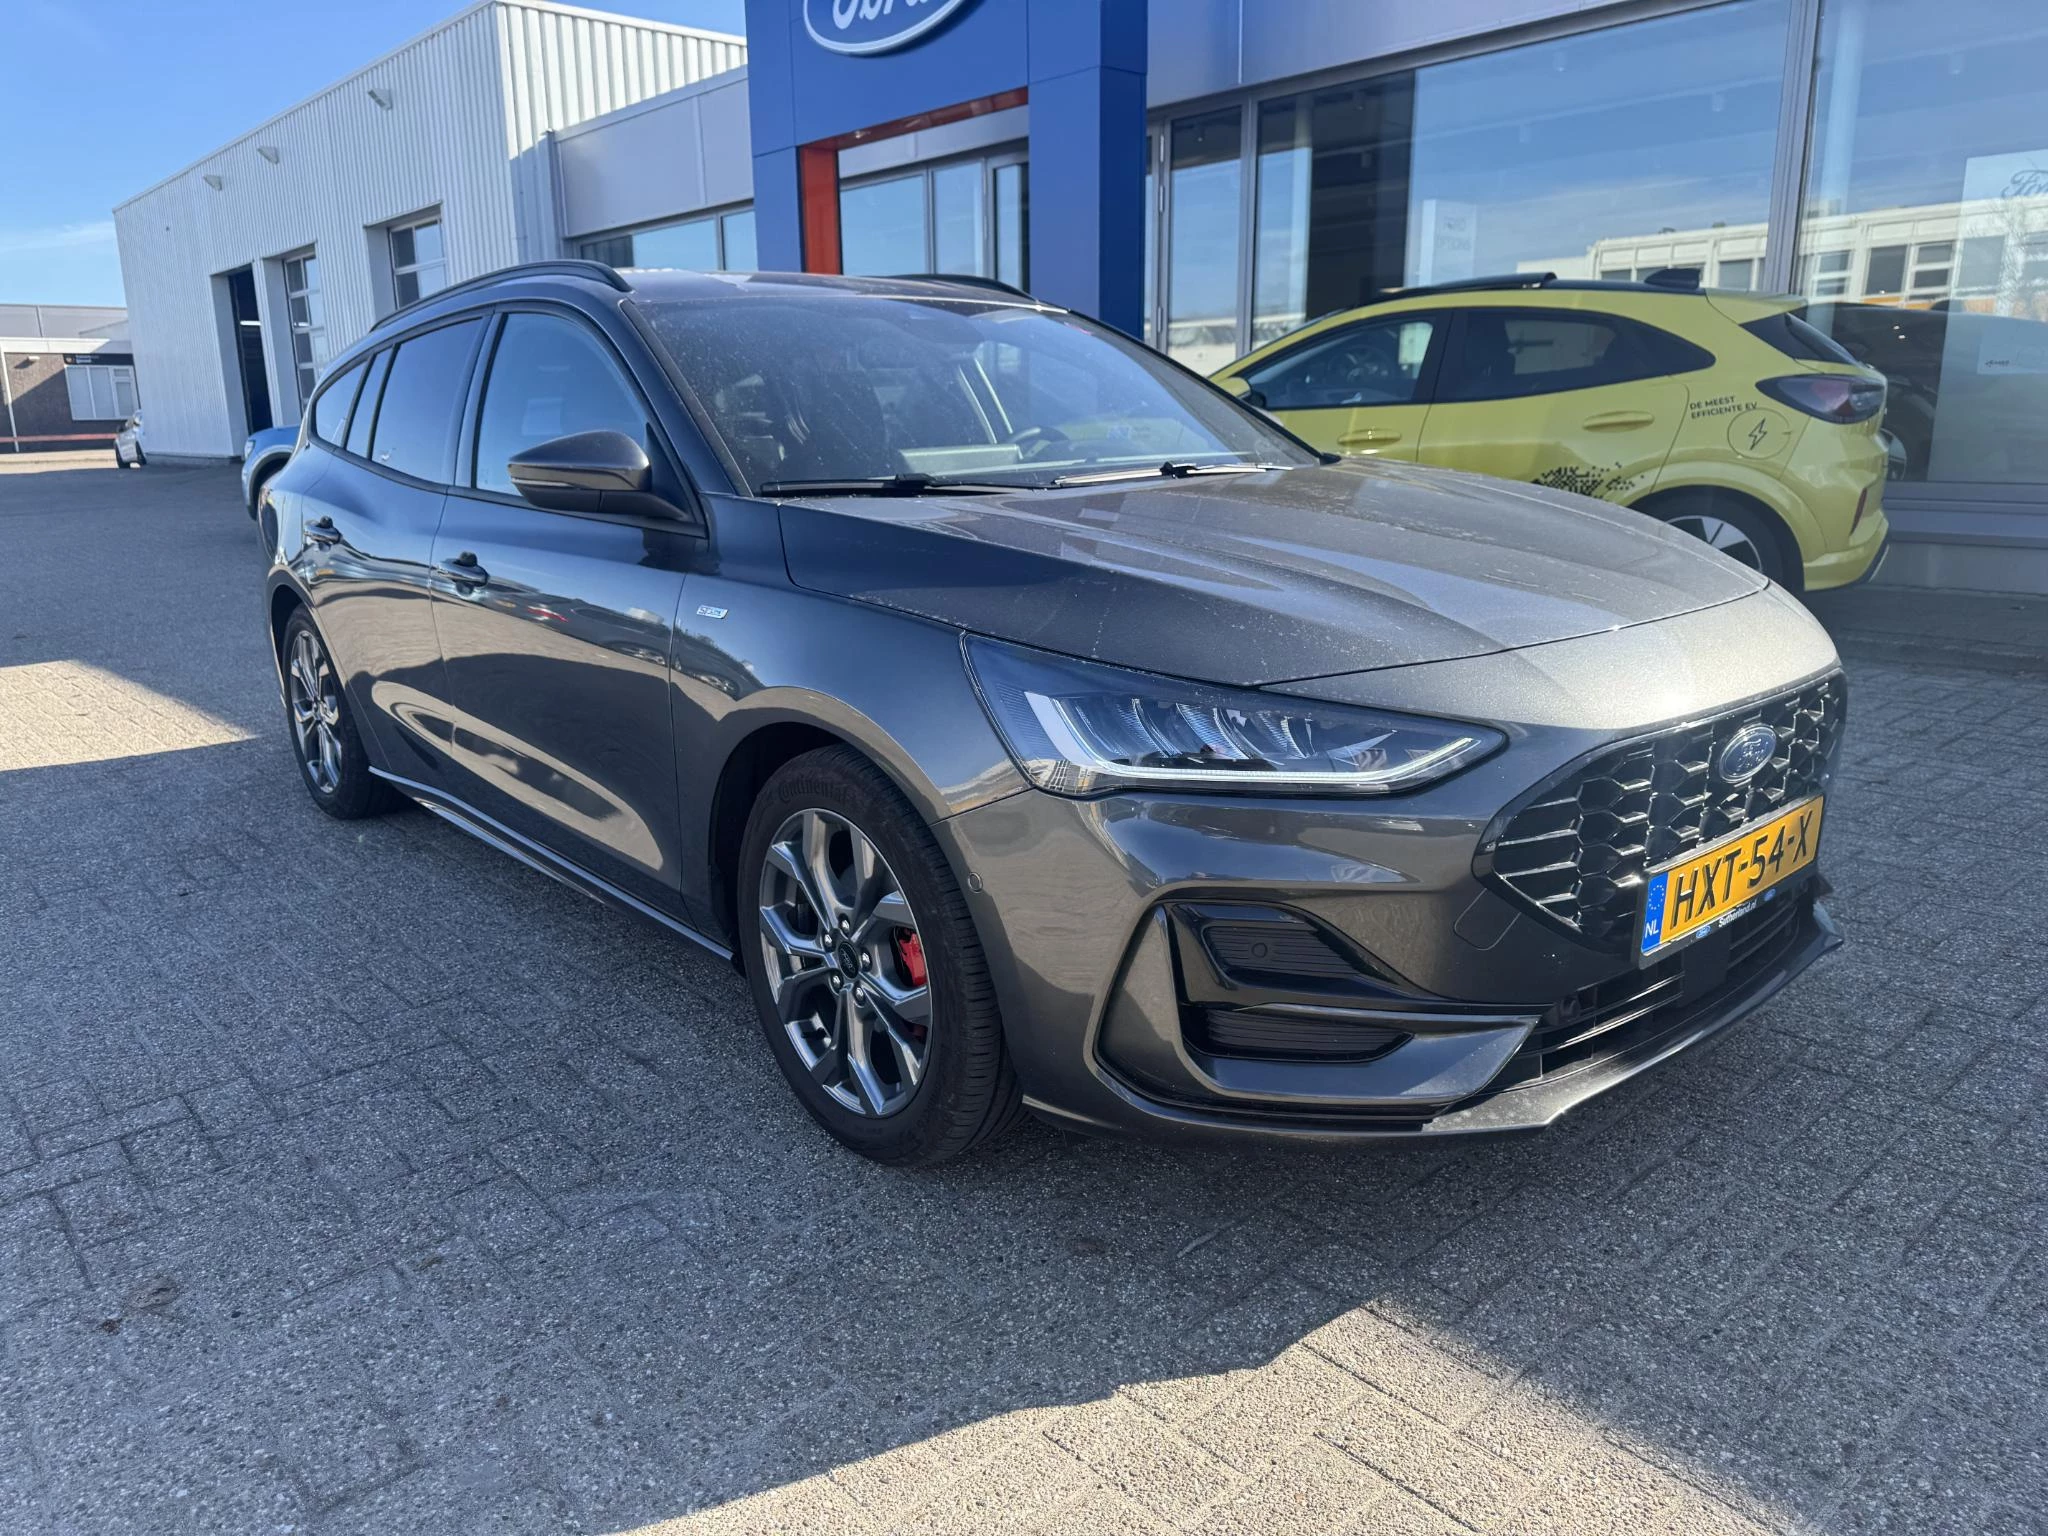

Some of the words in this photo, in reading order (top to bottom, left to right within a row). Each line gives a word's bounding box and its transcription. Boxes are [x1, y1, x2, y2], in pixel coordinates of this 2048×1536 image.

[1690, 400, 1702, 410] DE
[1705, 396, 1735, 407] MEEST
[1691, 404, 1742, 418] EFFICIENTE
[1745, 402, 1757, 410] EV
[1670, 809, 1813, 930] HXT-54-X
[1644, 919, 1659, 939] NL
